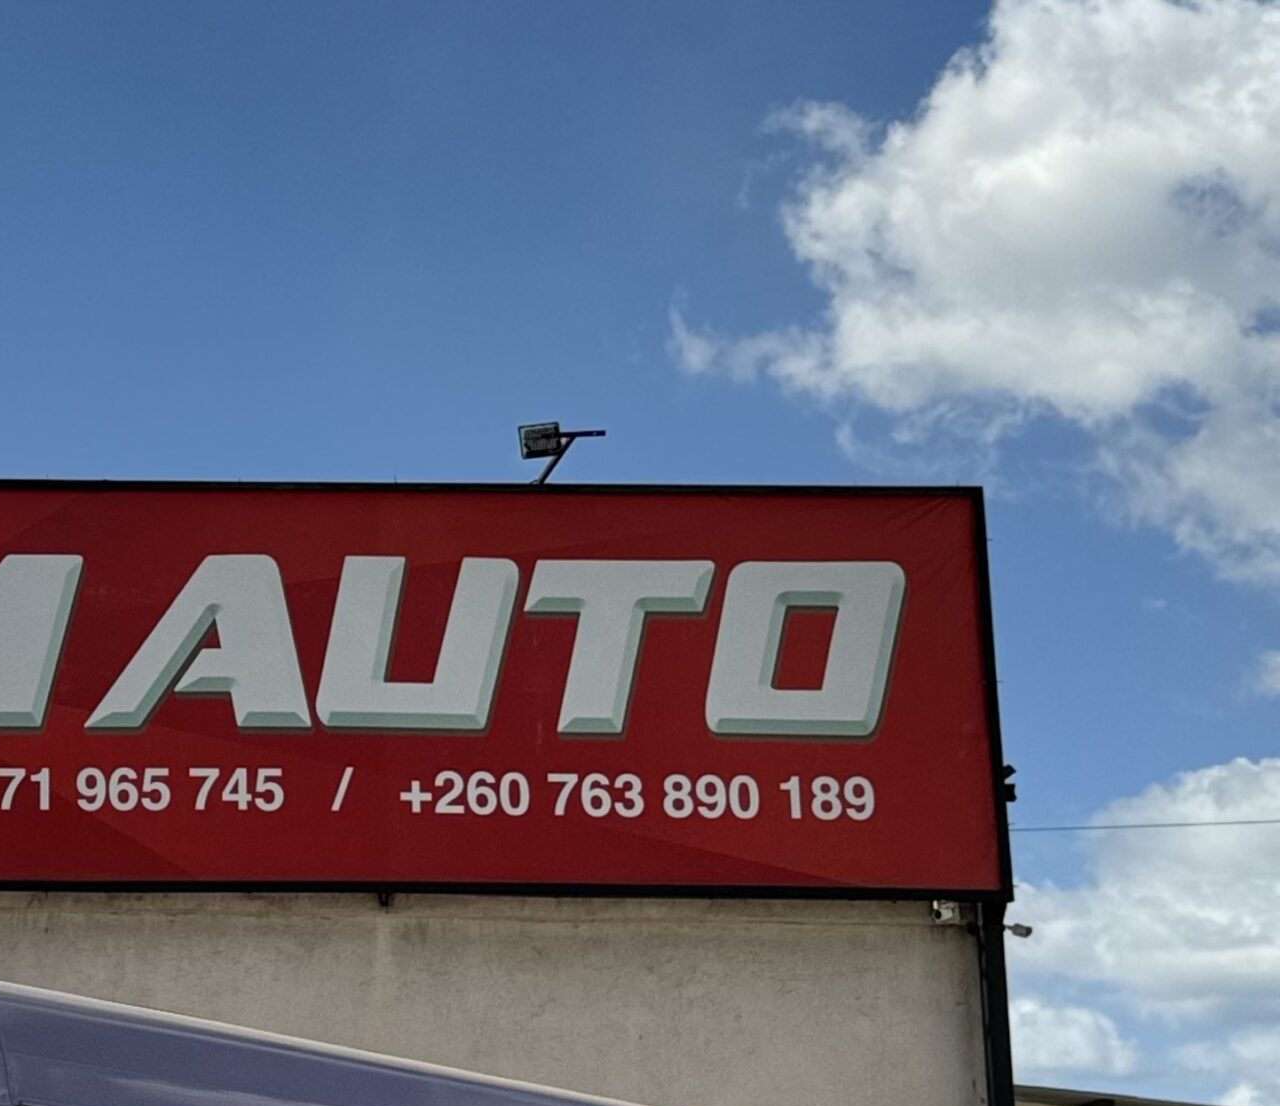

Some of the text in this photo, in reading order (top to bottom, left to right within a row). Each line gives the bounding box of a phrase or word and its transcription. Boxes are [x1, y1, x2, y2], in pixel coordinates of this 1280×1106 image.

[83, 553, 907, 739] AUTO
[75, 766, 171, 812] 965
[188, 767, 285, 812] 745
[331, 766, 354, 812] /
[399, 770, 531, 817] +260
[546, 772, 645, 818] 763
[662, 773, 760, 820] 890
[779, 775, 876, 821] 189
